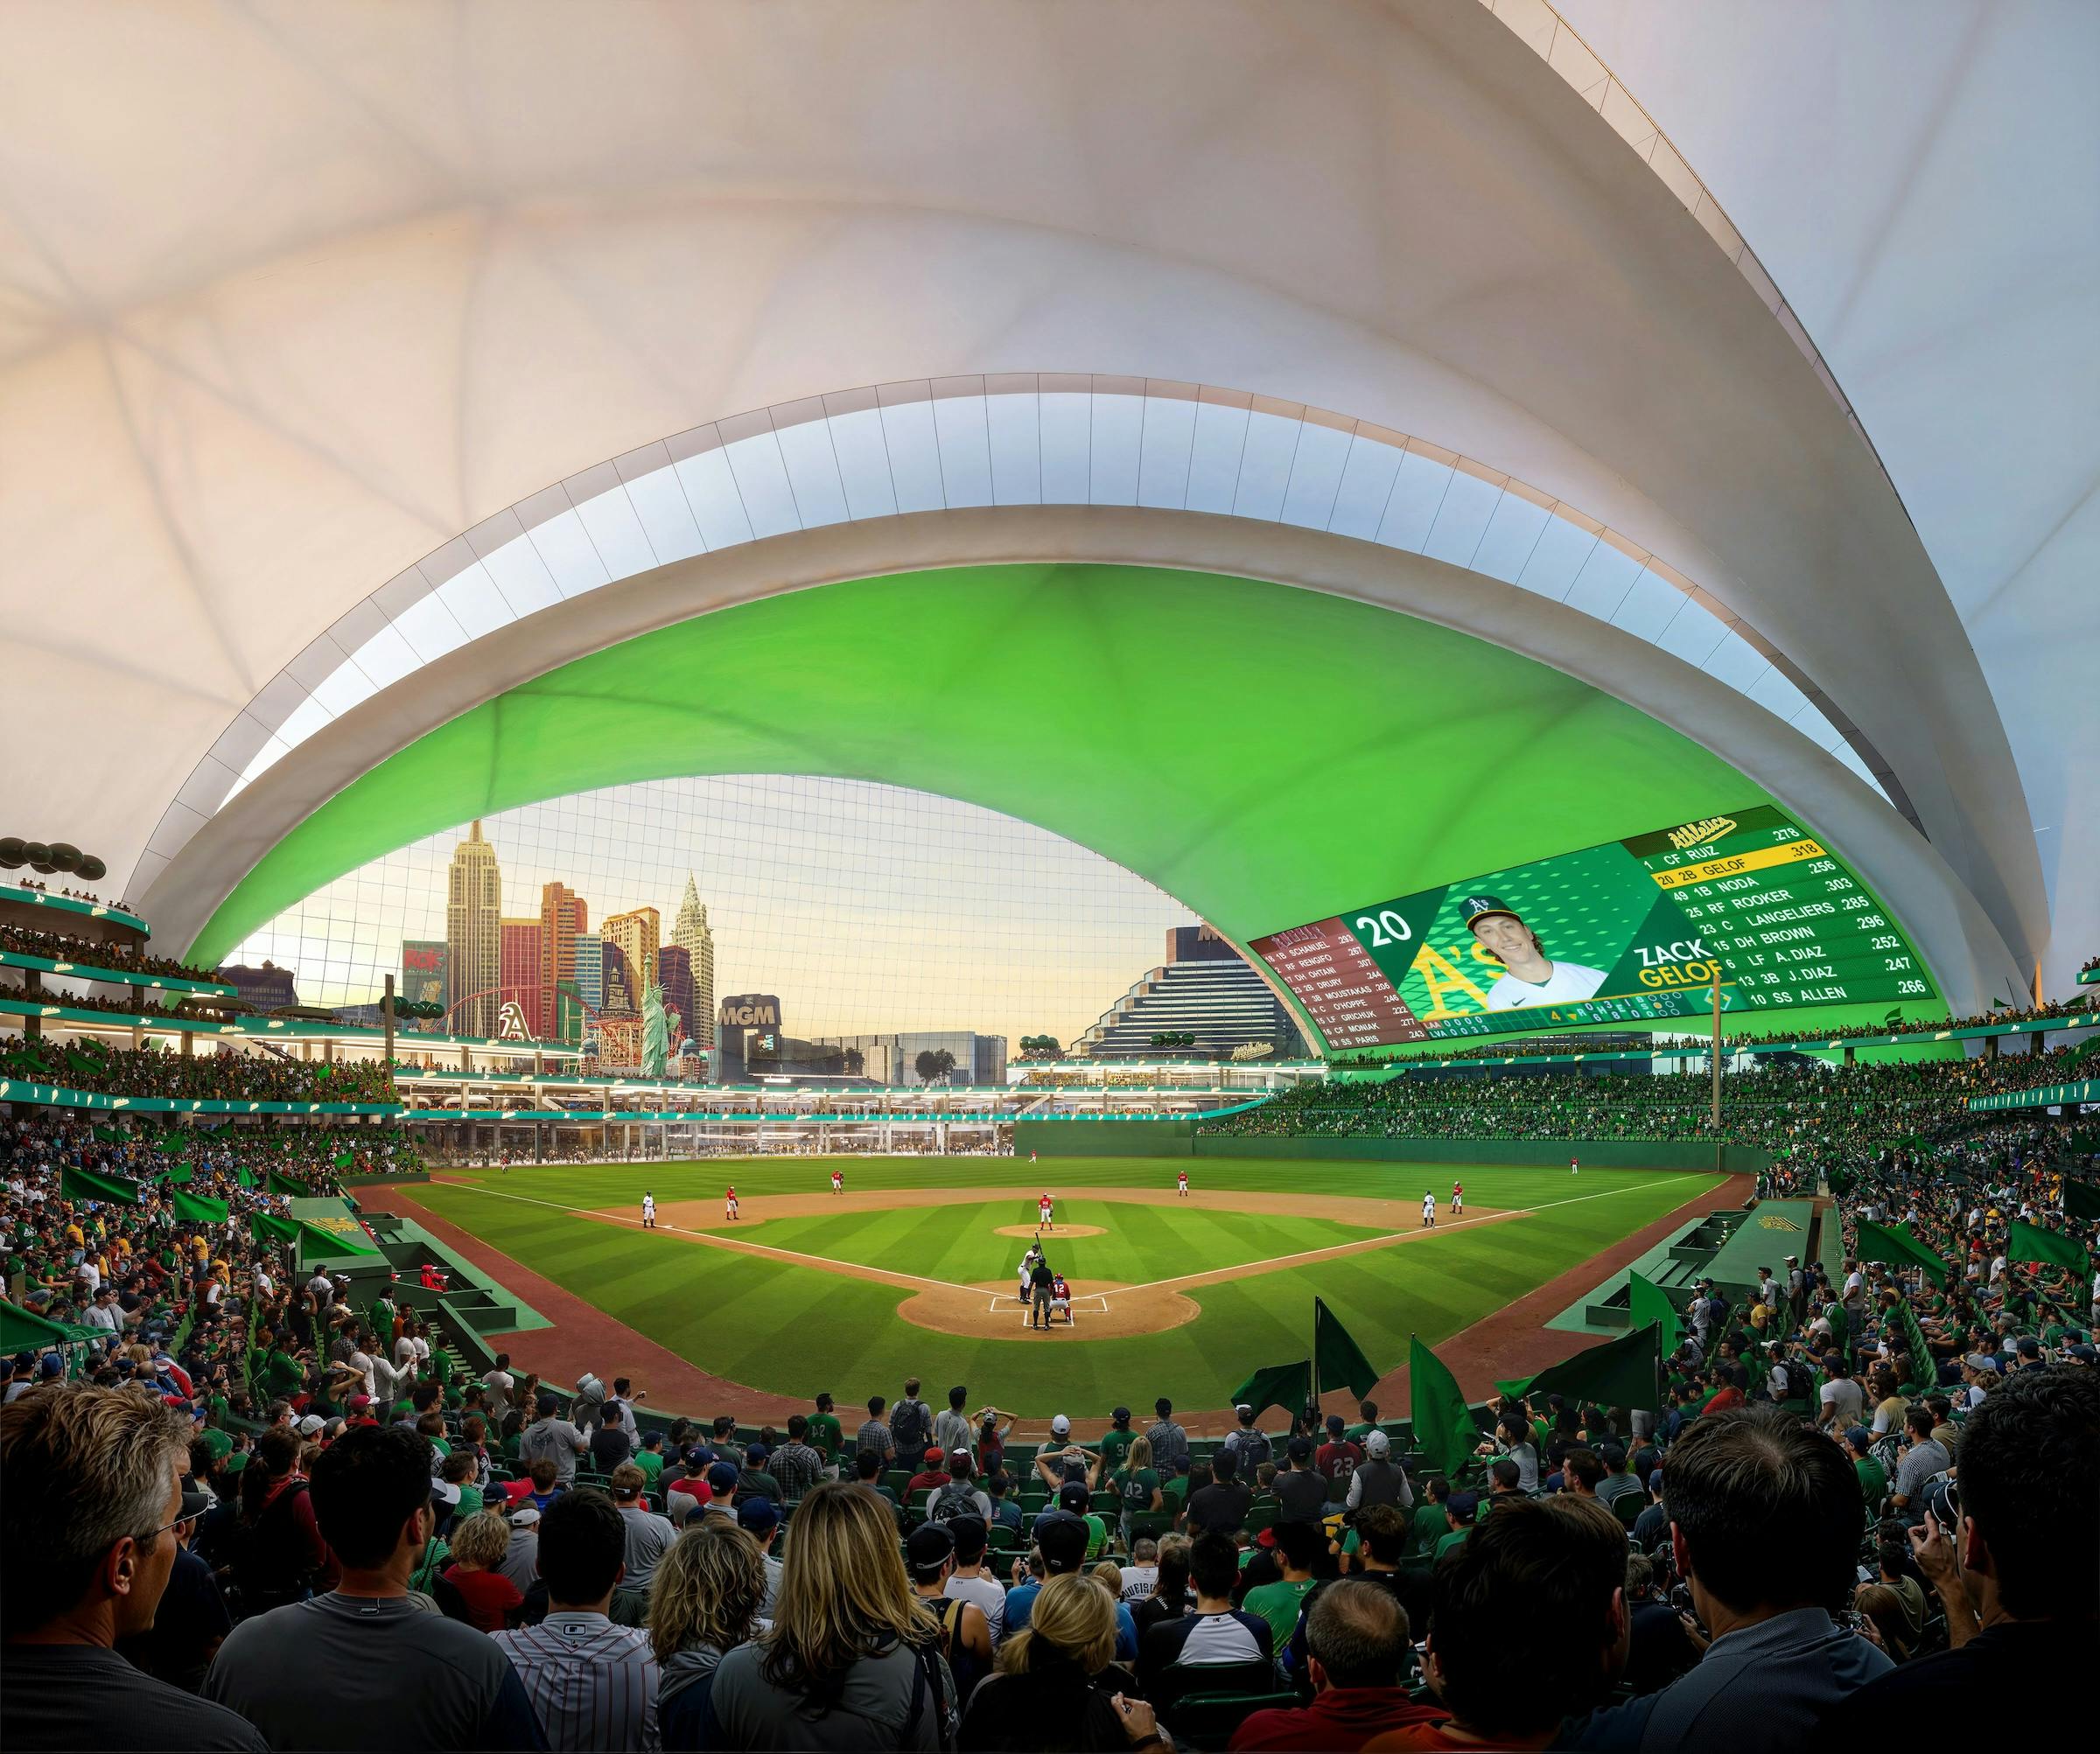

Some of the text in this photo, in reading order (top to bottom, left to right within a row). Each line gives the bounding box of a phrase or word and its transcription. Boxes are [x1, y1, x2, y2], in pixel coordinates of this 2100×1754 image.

[1668, 816, 1735, 849] Athletics
[1644, 828, 1800, 870] 1 CF RUIZ .278
[1657, 843, 1818, 885] 20 2B GELOF .318
[1673, 860, 1837, 902] 49 1B NODA .256
[1468, 898, 1489, 914] A's
[1685, 878, 1853, 919] 25 RF ROOKER .303
[1699, 896, 1870, 935] 23 C LANGELIERS .285
[1357, 910, 1411, 947] 20
[1712, 915, 1886, 952] 15 DH BROWN .296
[1277, 952, 1287, 961] 1B
[1289, 941, 1330, 956] SCHANUEL
[1338, 934, 1354, 945] .293
[1285, 962, 1296, 971] RF
[1298, 954, 1333, 968] RENGIFO
[1348, 947, 1362, 956] .267
[1633, 938, 1714, 967] ZACK
[1726, 959, 1736, 969] 6
[1747, 954, 1765, 967] LF
[1872, 935, 1900, 950] .252
[1296, 973, 1307, 982] DH
[1309, 967, 1337, 979] OHTANI
[1357, 958, 1372, 968] .307
[1316, 977, 1343, 989] DRURY
[1367, 971, 1382, 980] .244
[1638, 959, 1723, 988] GELOF
[1738, 975, 1755, 988] 13
[1760, 973, 1781, 985] 3B
[1885, 956, 1912, 971] .247
[1325, 986, 1372, 1000] MOUSTAKAS
[1334, 999, 1368, 1010] O'HOPPE
[1383, 995, 1400, 1003] .246
[1750, 980, 1926, 1005] 10 SS ALLEN .266
[718, 1006, 775, 1025] MGM
[1341, 1010, 1377, 1022] GRICHUK
[1392, 1006, 1408, 1015] .222
[1424, 1021, 1442, 1030] LAA
[1551, 1010, 1561, 1021] 4
[1334, 1026, 1344, 1035] CF
[1348, 1022, 1380, 1033] MONIAK
[1401, 1018, 1415, 1027] .277
[1354, 1035, 1380, 1044] PARIS
[1409, 1030, 1424, 1038] .243
[1054, 1283, 1065, 1293] 12
[1333, 1457, 1354, 1478] 23
[1124, 1481, 1143, 1499] 42
